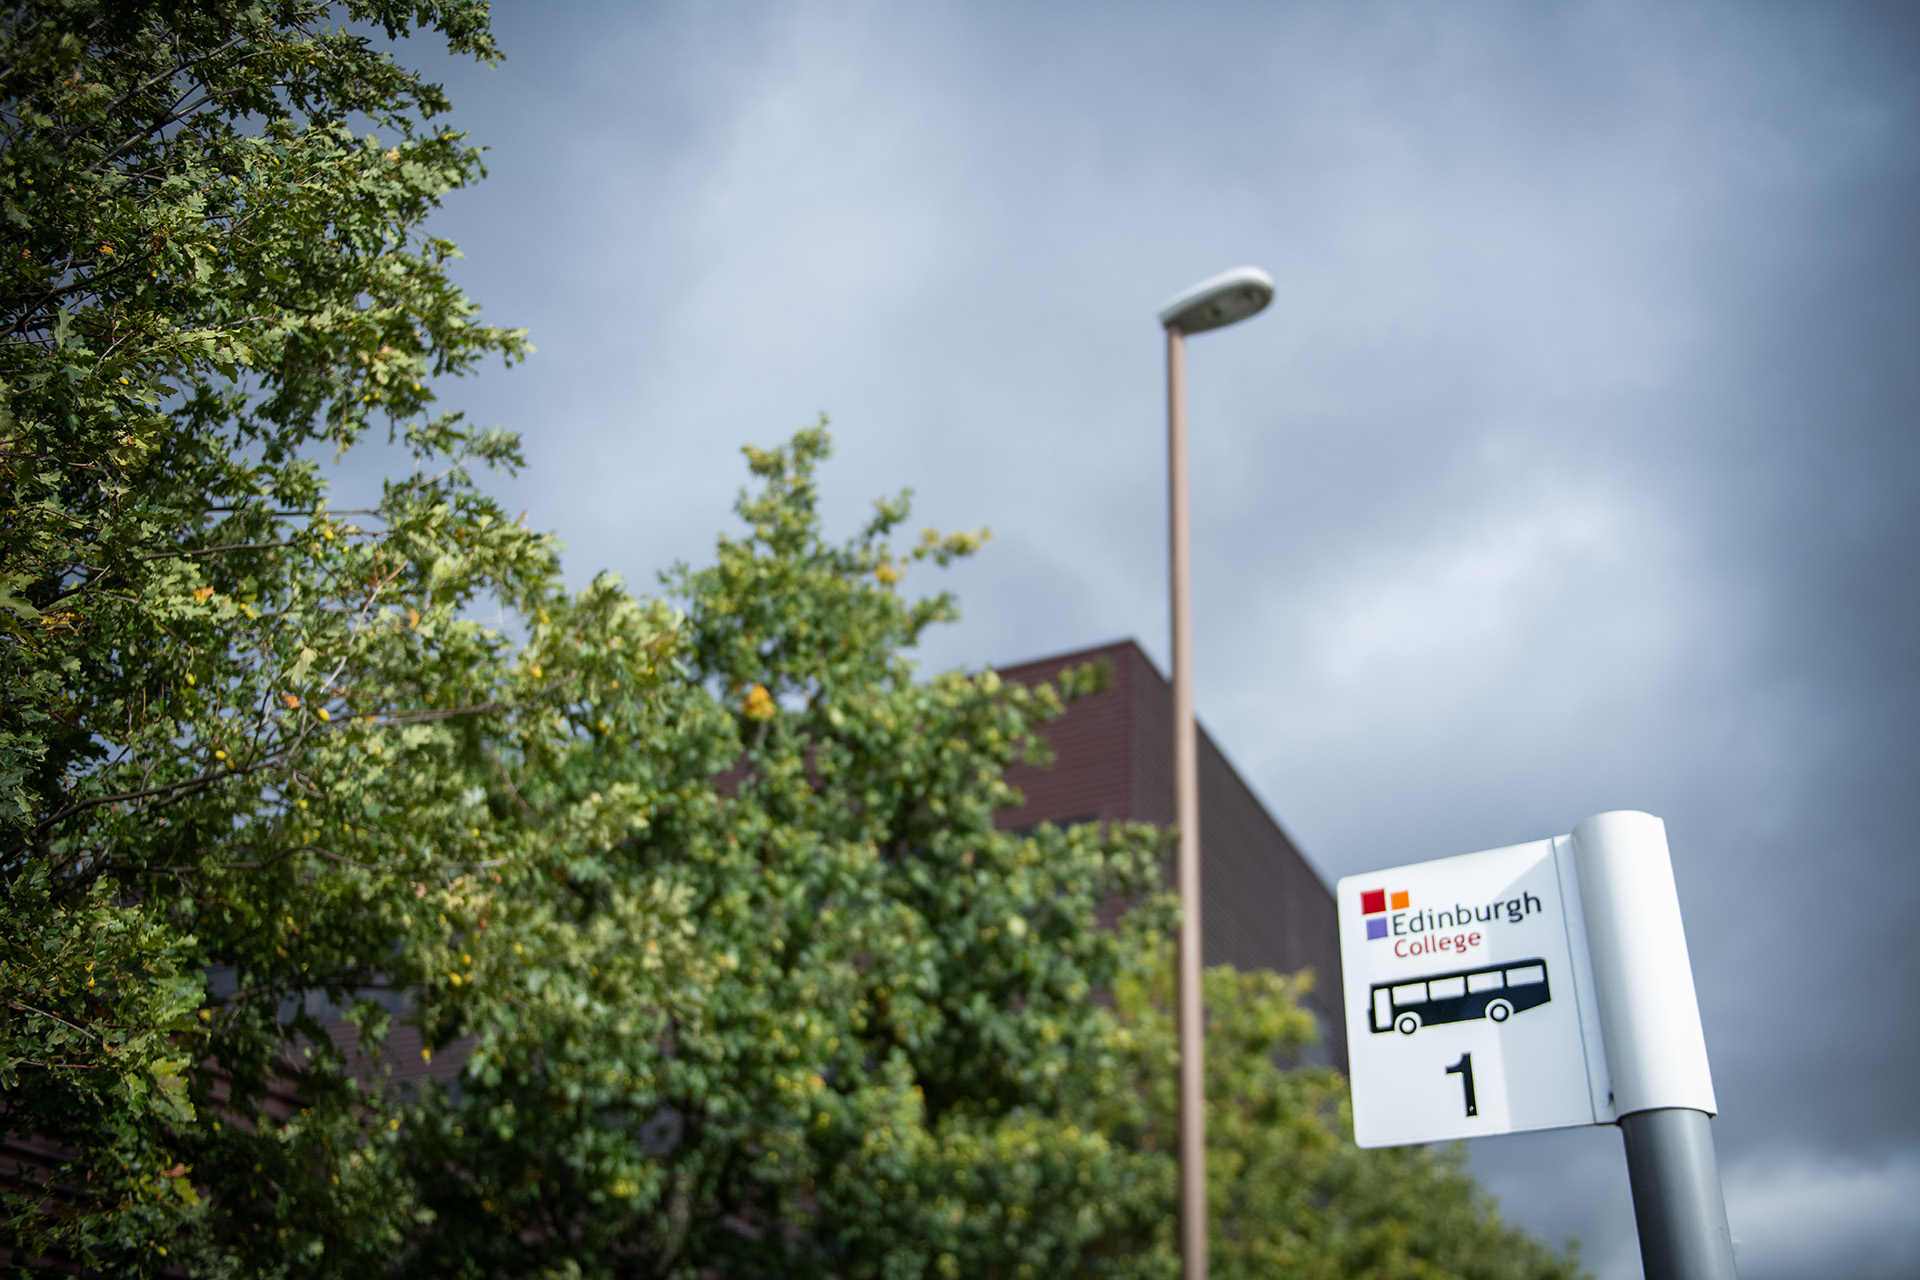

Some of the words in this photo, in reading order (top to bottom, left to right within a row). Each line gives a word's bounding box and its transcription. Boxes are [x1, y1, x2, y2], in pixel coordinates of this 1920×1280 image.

[1392, 891, 1542, 936] Edinburgh
[1394, 931, 1482, 958] College
[1445, 1052, 1478, 1117] 1
